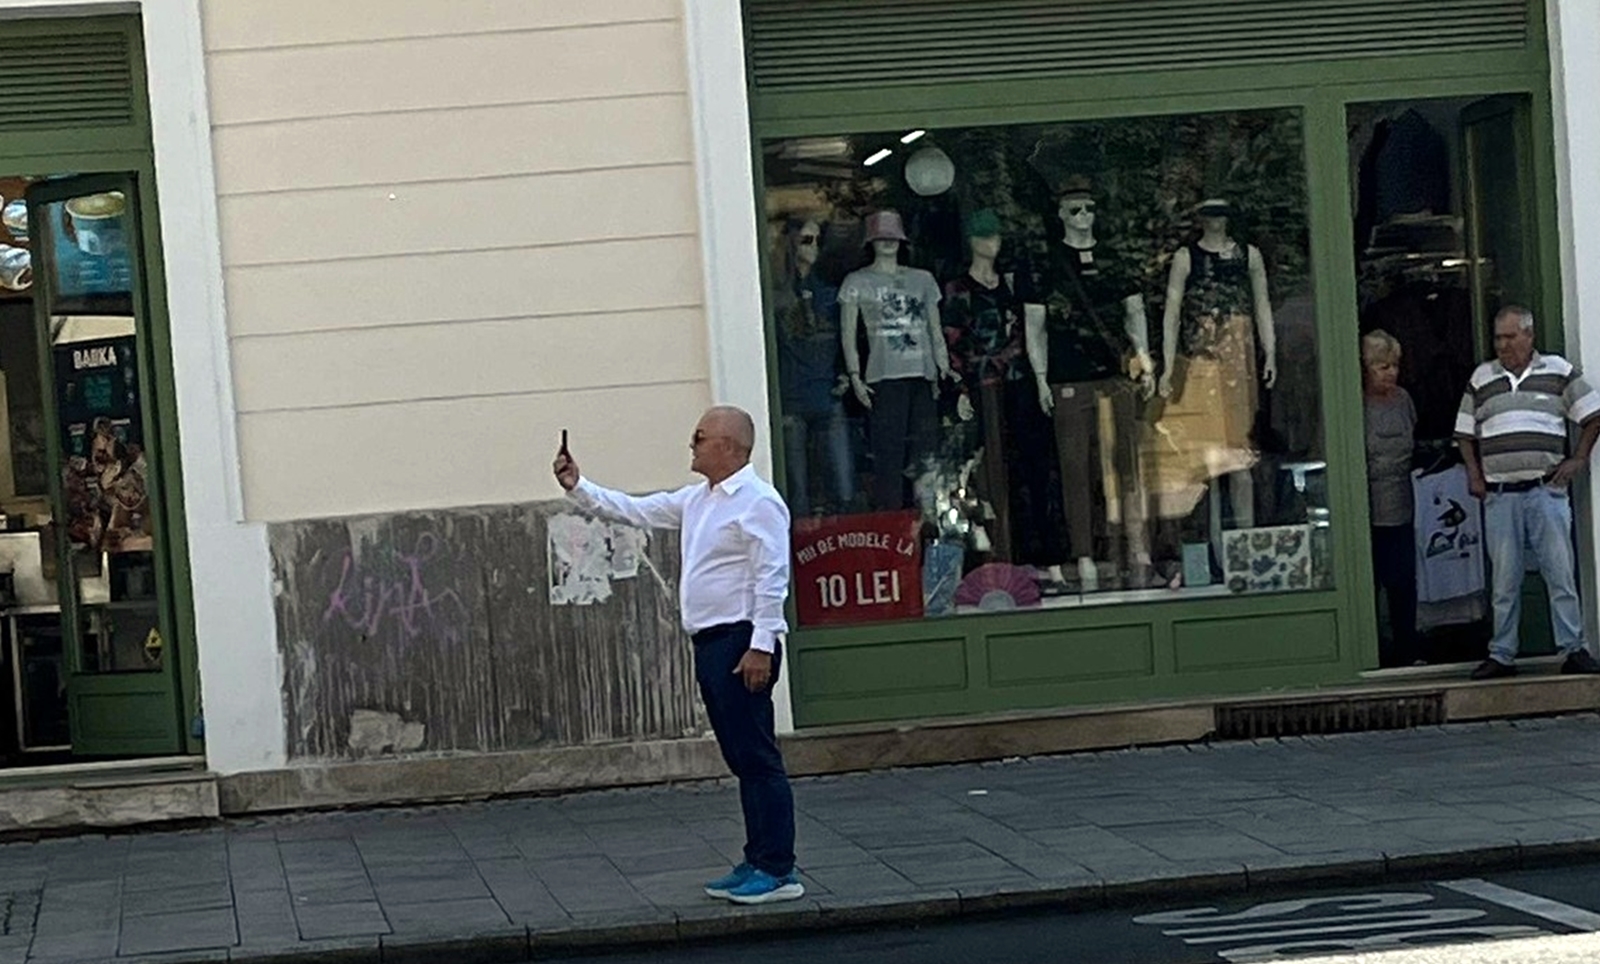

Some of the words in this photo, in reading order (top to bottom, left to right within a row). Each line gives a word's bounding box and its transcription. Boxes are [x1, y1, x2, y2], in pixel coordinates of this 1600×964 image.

[816, 536, 837, 555] DE
[837, 532, 891, 549] MODELE
[896, 537, 914, 556] LA
[815, 574, 847, 608] 10
[855, 570, 900, 605] LEI
